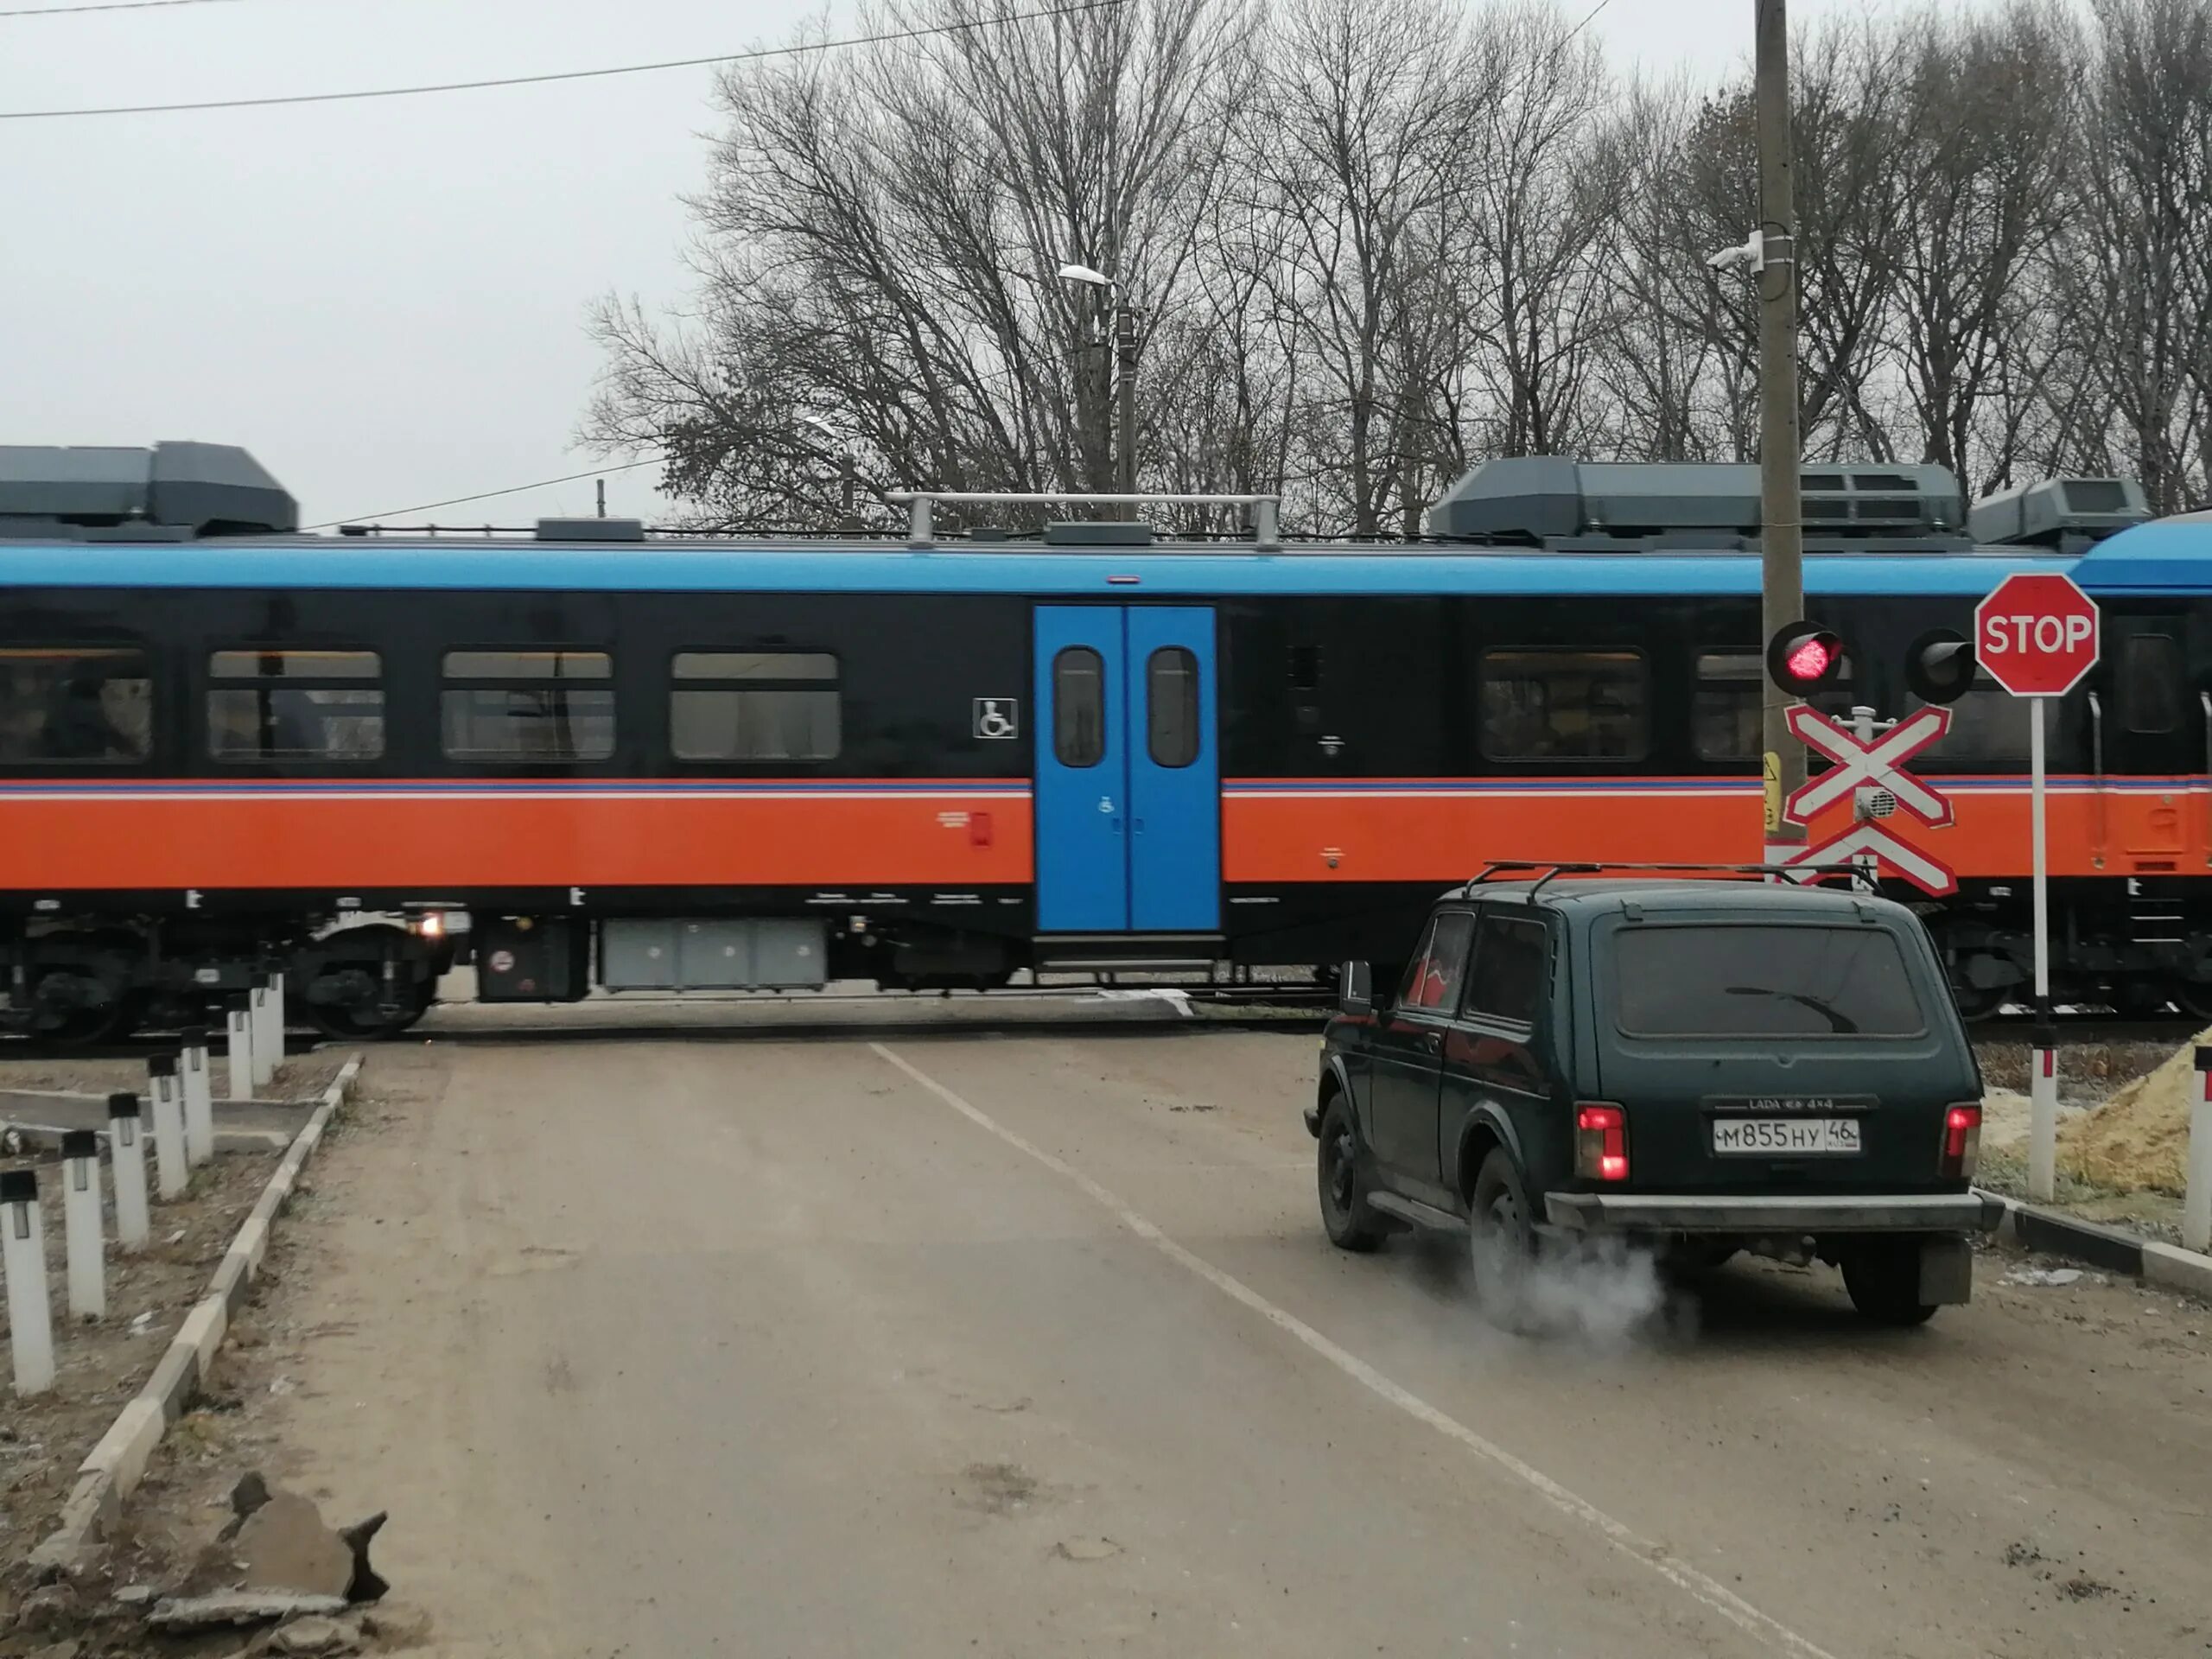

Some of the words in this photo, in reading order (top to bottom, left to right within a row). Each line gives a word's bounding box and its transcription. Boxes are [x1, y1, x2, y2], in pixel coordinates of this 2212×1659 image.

[1986, 615, 2092, 653] STOP
[1749, 1099, 1781, 1109] LADA
[1828, 1122, 1851, 1140] 46
